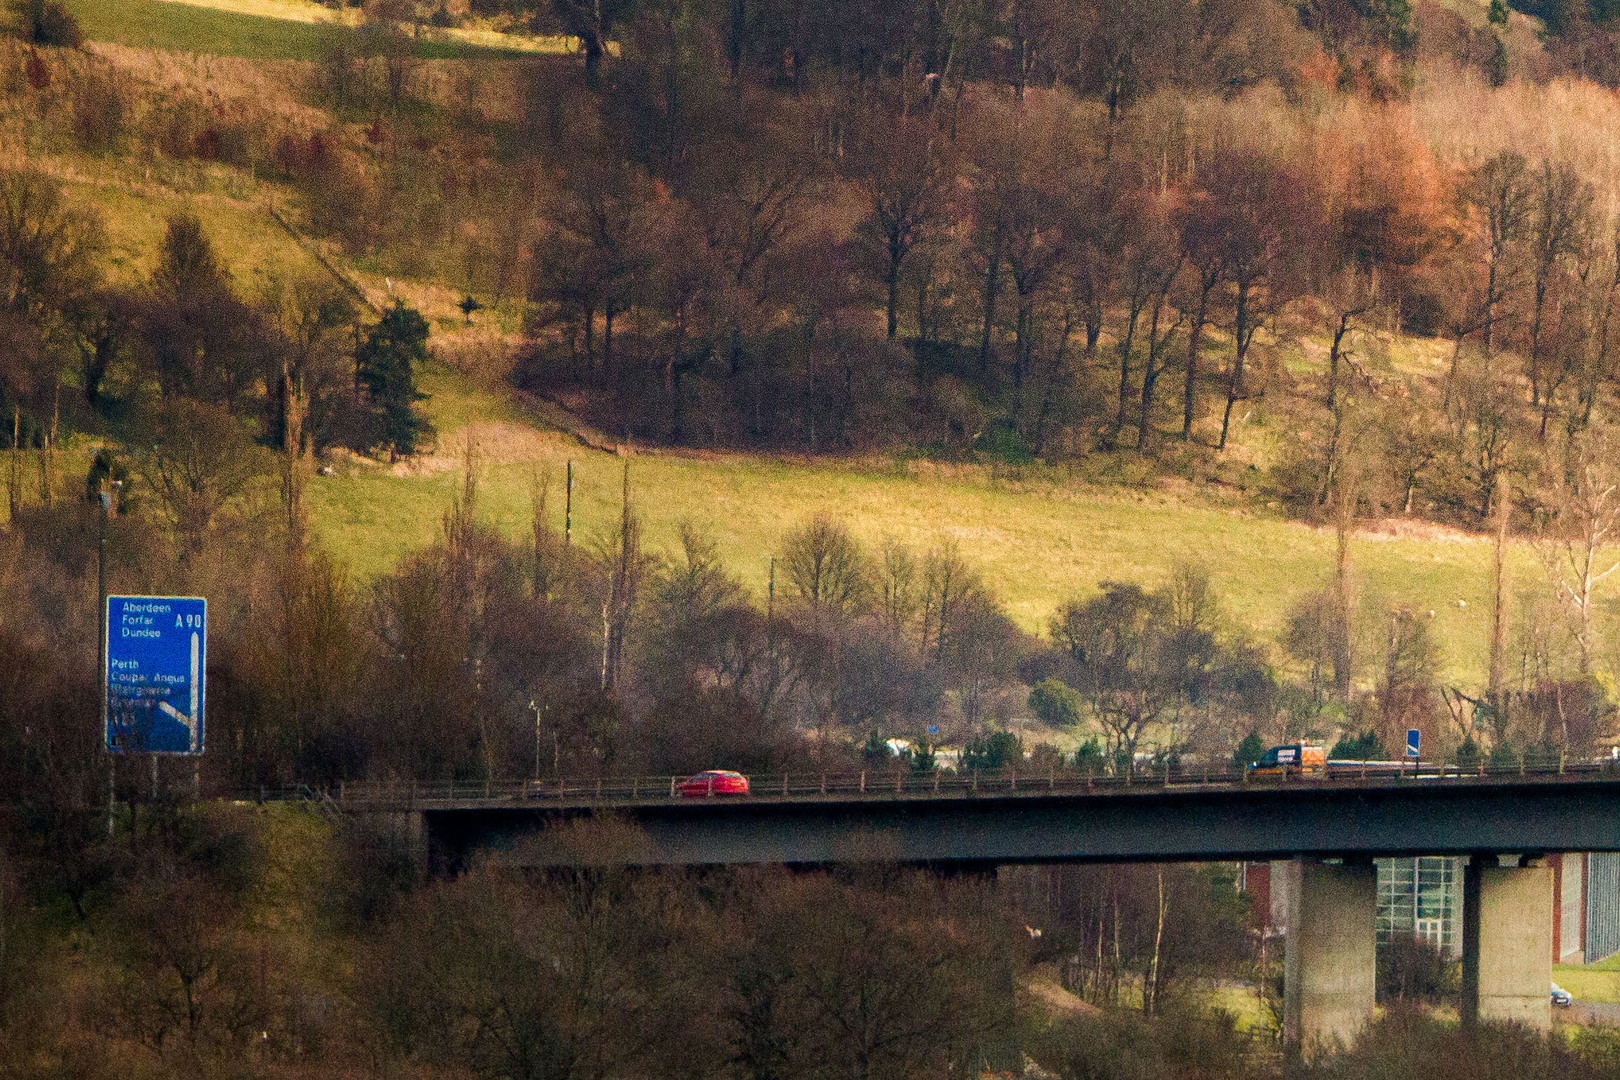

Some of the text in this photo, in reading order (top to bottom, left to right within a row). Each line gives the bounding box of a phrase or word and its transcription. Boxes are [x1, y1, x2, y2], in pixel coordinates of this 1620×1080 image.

[122, 602, 171, 613] Aberdeen
[122, 615, 153, 625] Forfar
[122, 627, 161, 637] Dundee
[111, 658, 139, 669] Perth
[154, 672, 185, 683] Angus
